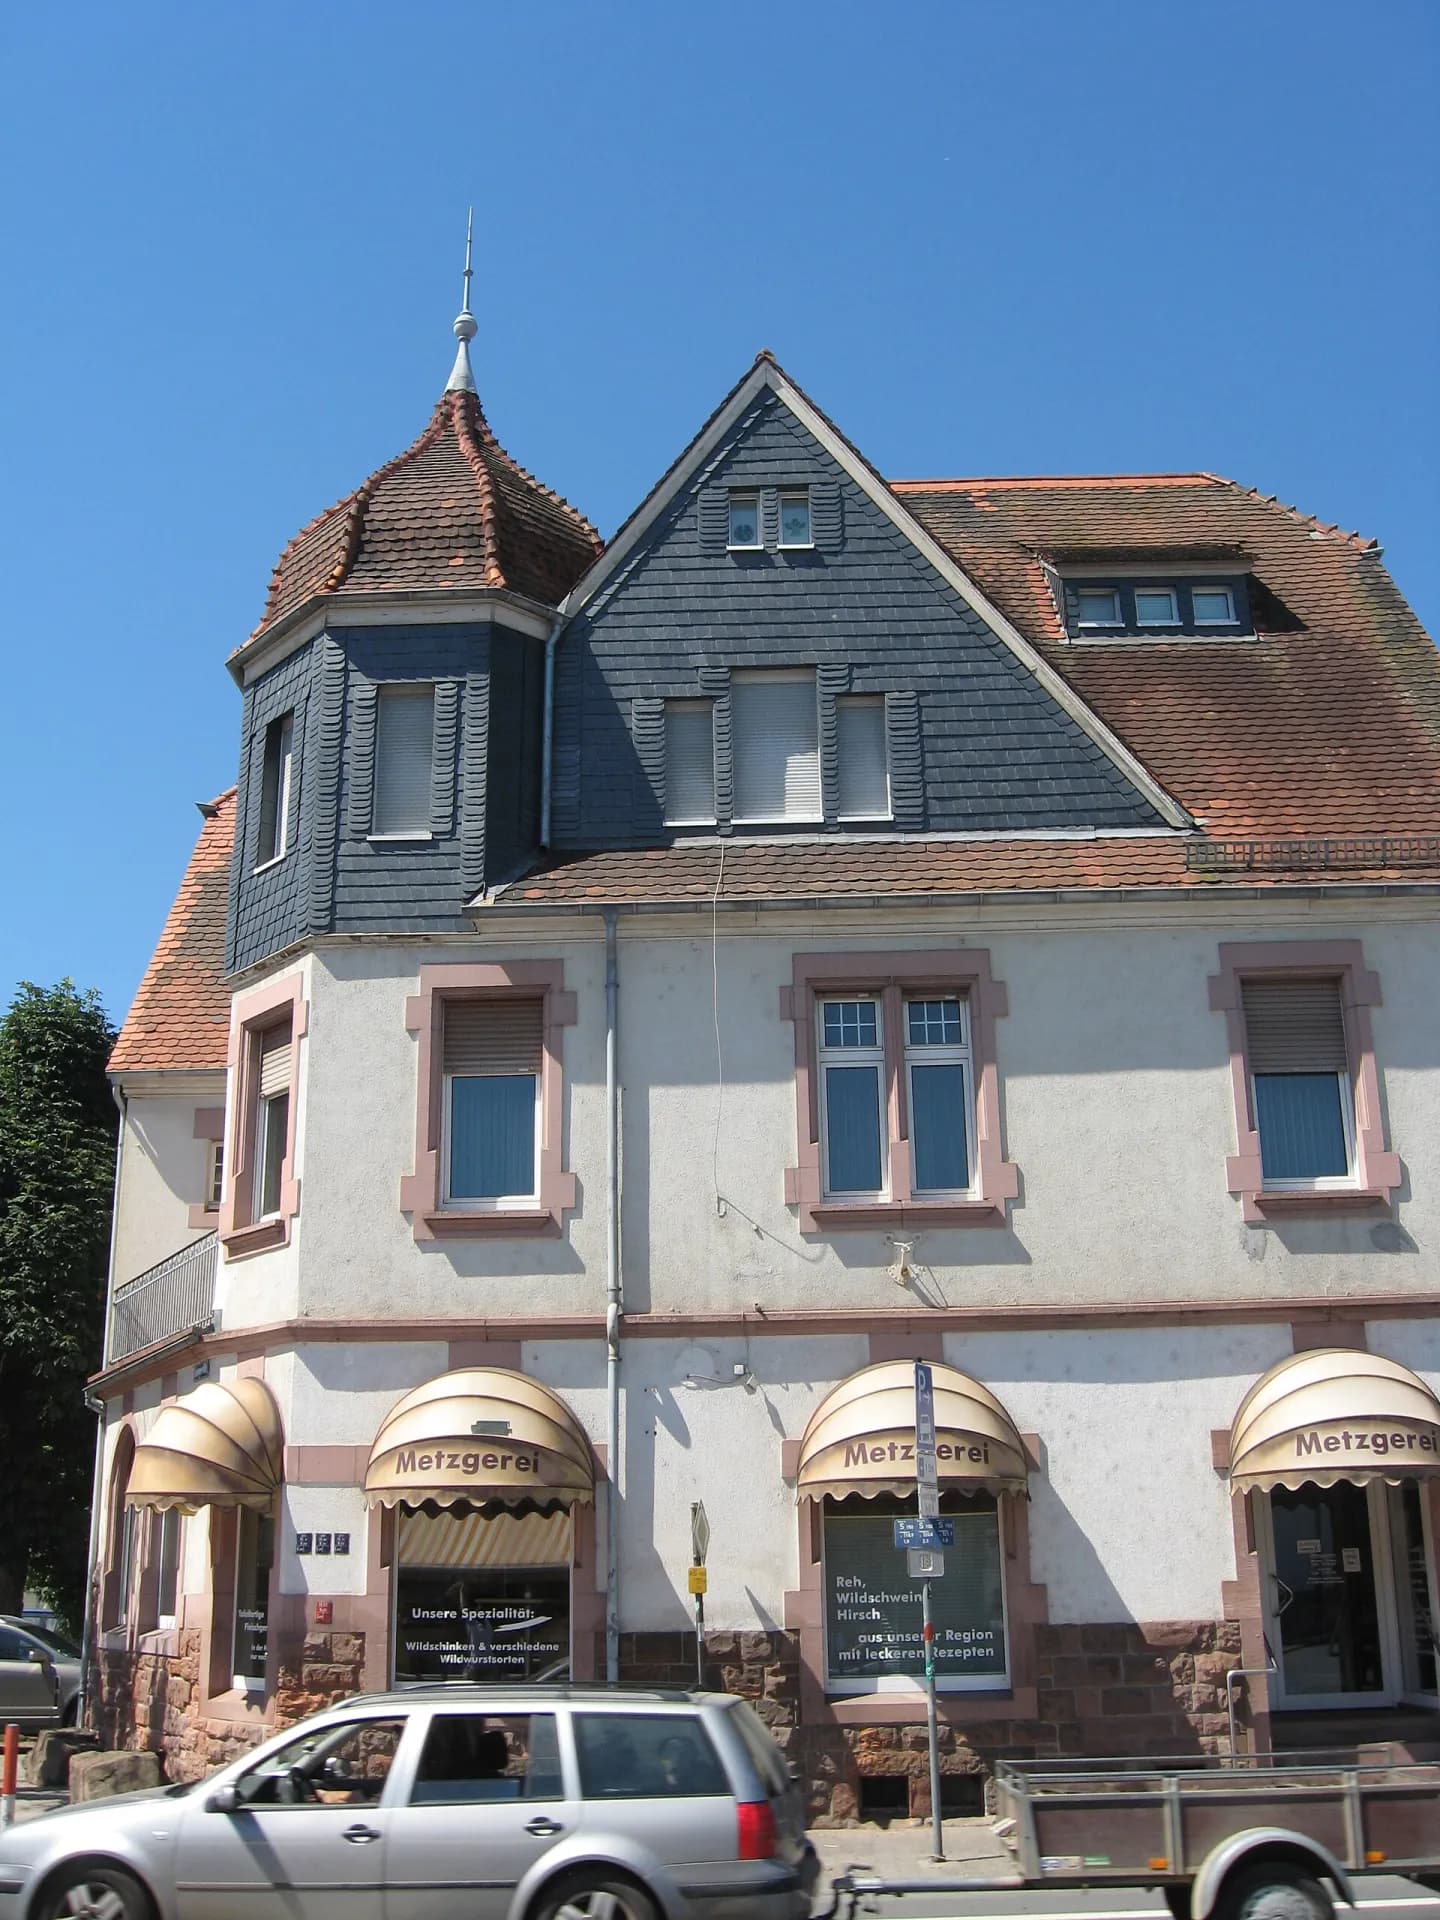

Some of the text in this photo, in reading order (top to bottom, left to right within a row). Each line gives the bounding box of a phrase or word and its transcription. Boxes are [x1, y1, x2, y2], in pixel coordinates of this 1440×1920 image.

[1296, 1430, 1438, 1457] Metzgerei
[844, 1441, 990, 1468] Metzerei
[395, 1450, 539, 1475] Metzgerei
[836, 1576, 867, 1589] Reh,
[412, 1607, 535, 1621] Unsere Spezialität:
[837, 1607, 881, 1621] Hirsch
[858, 1629, 993, 1643] aus unserr Region
[405, 1641, 559, 1652] Wildschinken & verschiedene
[838, 1647, 861, 1660] mit
[866, 1647, 925, 1660] leckeren
[440, 1654, 525, 1664] Wildwurstsorten
